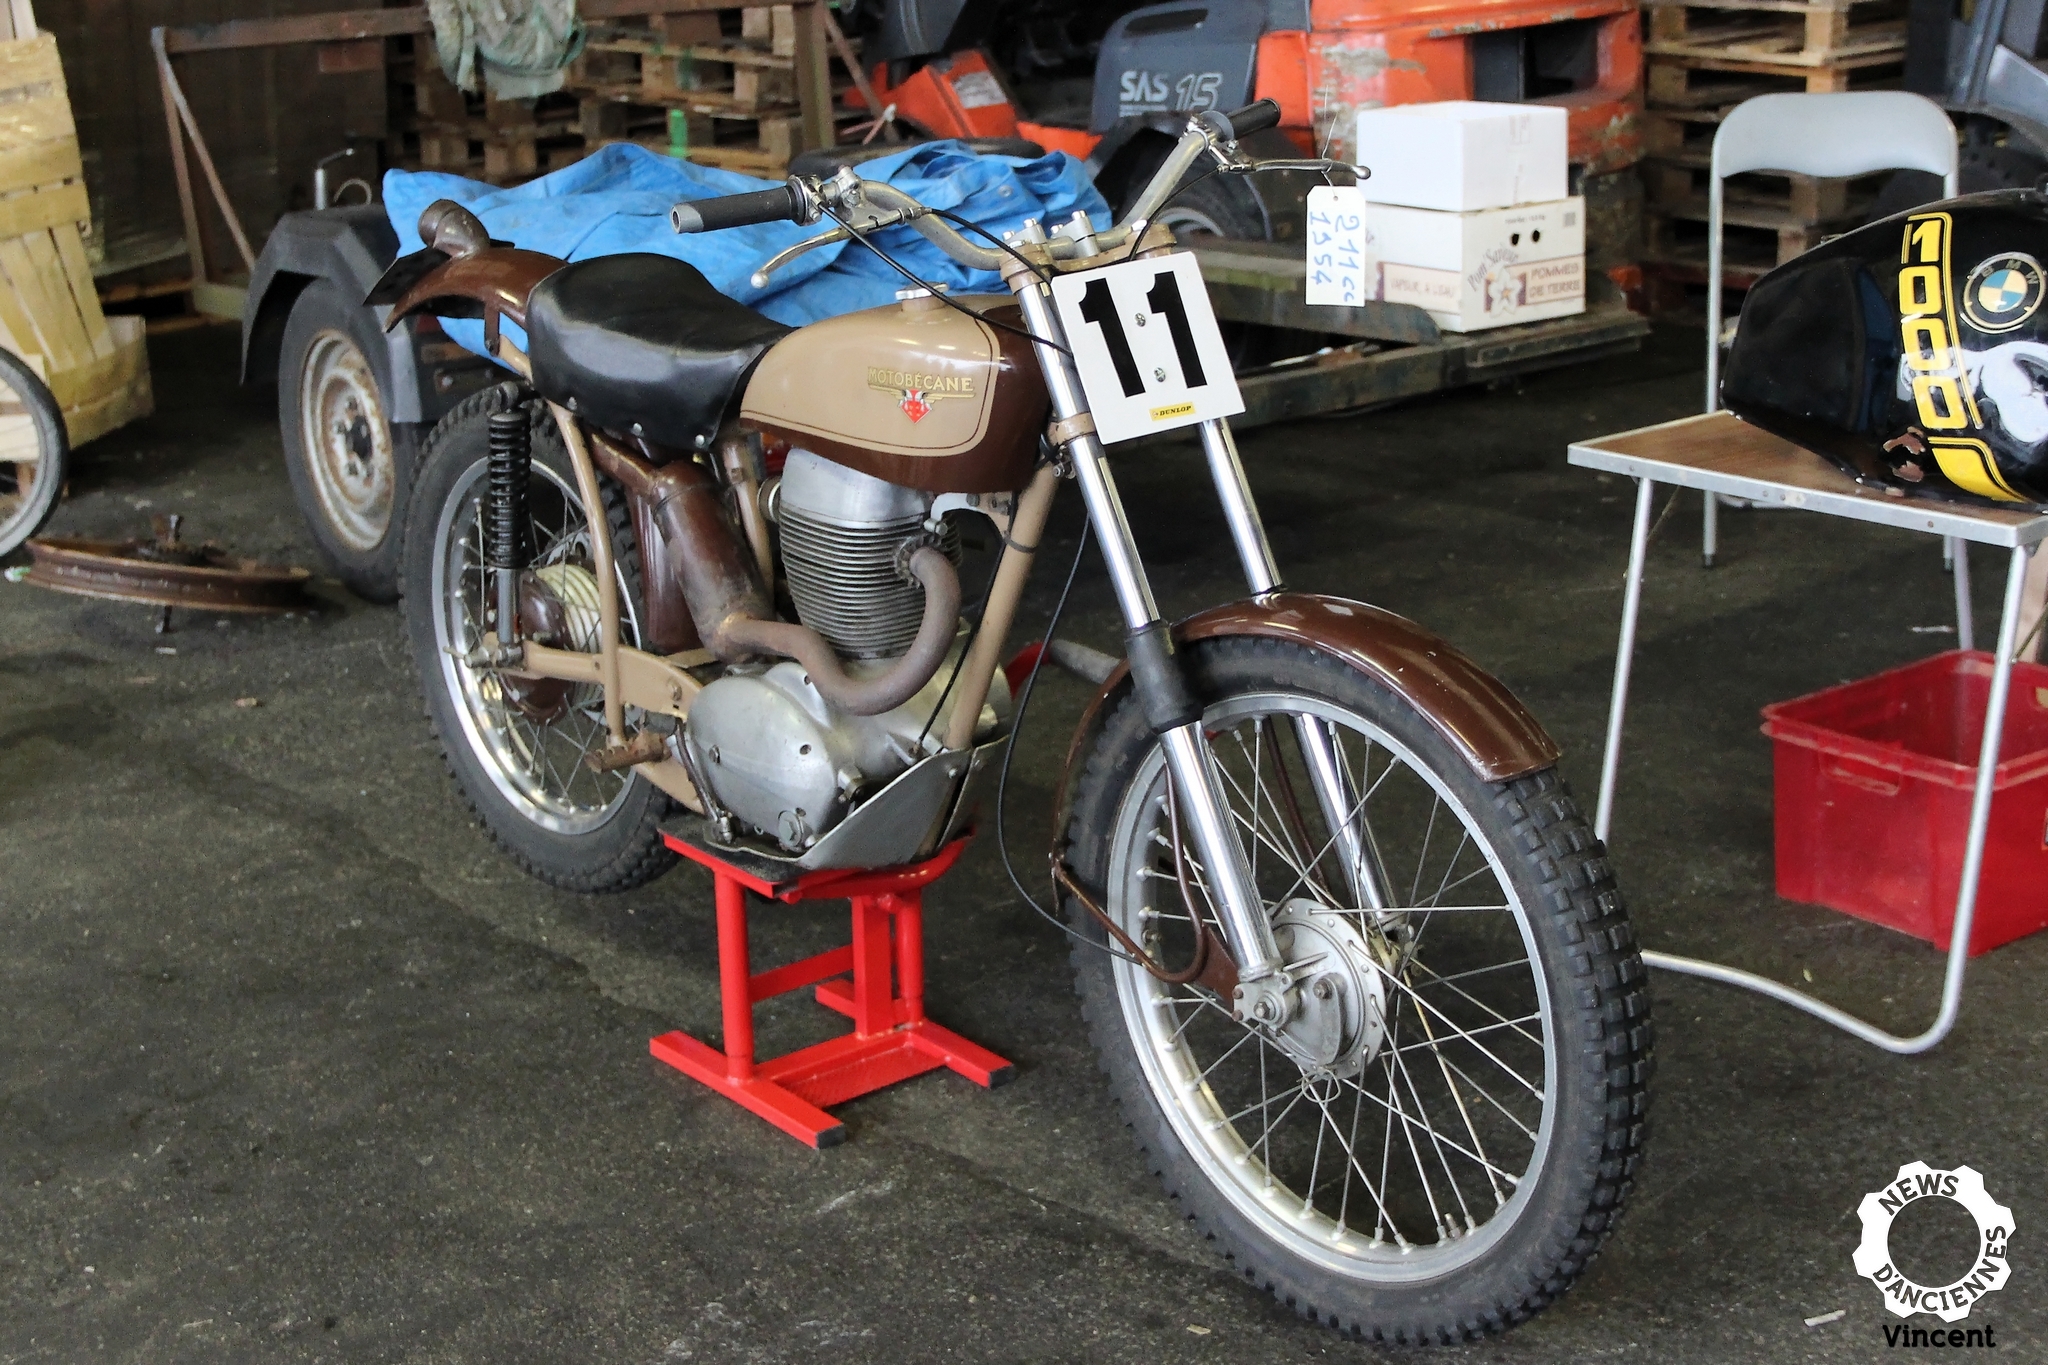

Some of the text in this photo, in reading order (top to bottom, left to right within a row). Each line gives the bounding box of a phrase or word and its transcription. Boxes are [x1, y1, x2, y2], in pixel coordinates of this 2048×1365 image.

[1119, 70, 1224, 111] SAS 15
[1531, 263, 1580, 280] POMMES
[1980, 258, 2040, 285] BMW
[1078, 270, 1208, 398] 11
[1899, 219, 1969, 430] 1000
[867, 366, 975, 392] MOTOBÉCANE
[1159, 405, 1192, 416] DUNLOP
